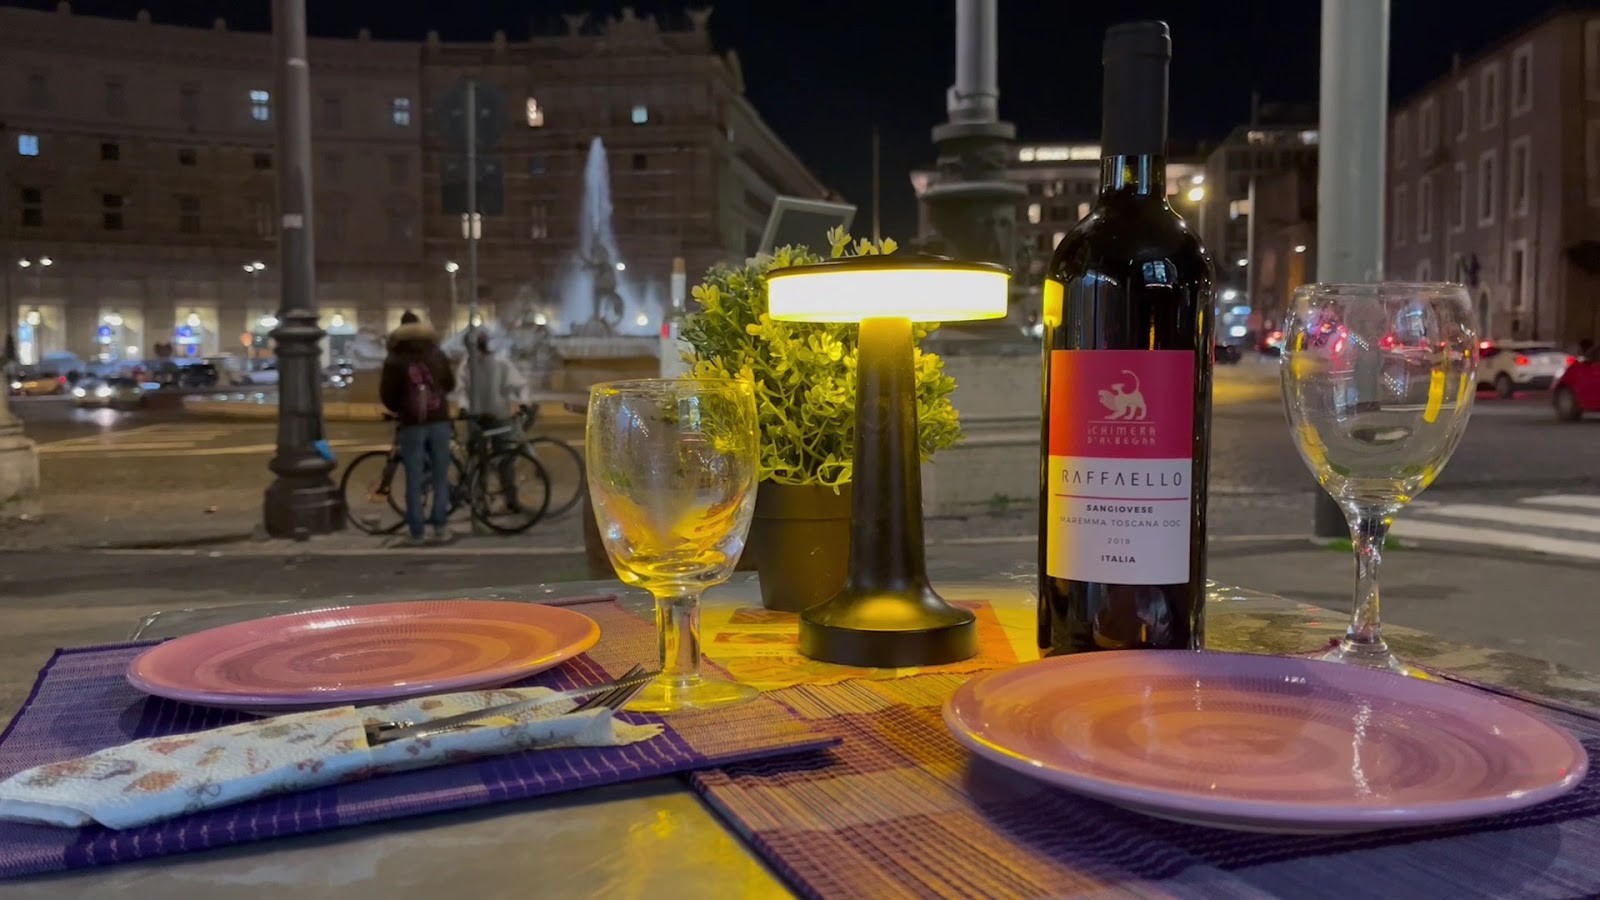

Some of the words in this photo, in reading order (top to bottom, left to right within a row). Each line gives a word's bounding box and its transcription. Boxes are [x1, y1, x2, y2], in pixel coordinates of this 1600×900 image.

[1061, 469, 1183, 487] RAFFAELLO
[1086, 504, 1154, 514] SANGIOVESE
[1060, 515, 1107, 527] MAREMMA
[1111, 519, 1159, 528] TOSCANA
[1162, 519, 1182, 528] DOC
[1101, 554, 1136, 563] ITALIA
